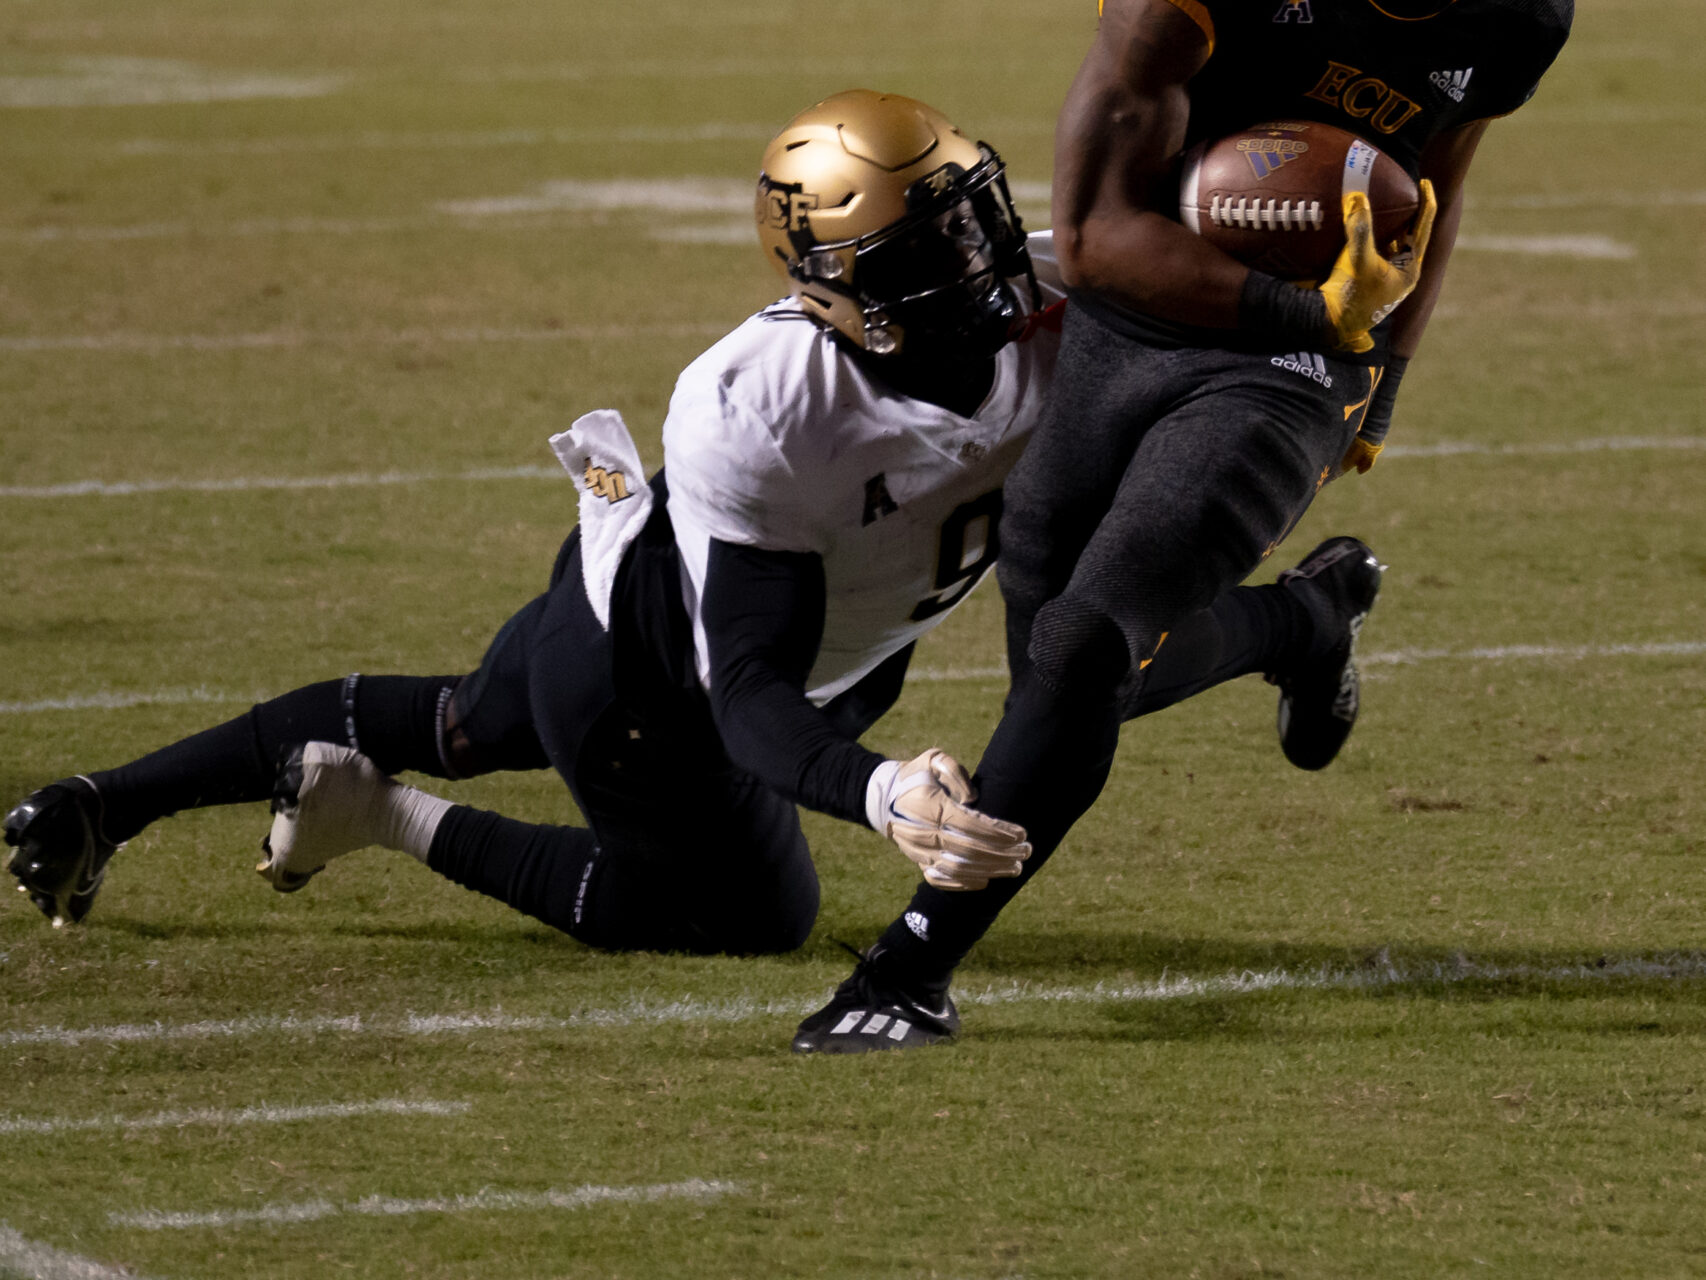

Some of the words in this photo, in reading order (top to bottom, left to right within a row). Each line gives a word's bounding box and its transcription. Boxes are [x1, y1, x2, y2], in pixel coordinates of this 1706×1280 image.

[1303, 60, 1424, 135] ECU
[1428, 71, 1465, 103] adidas
[1236, 138, 1309, 154] adidas
[1270, 356, 1333, 389] adidas
[909, 487, 1004, 622] 9
